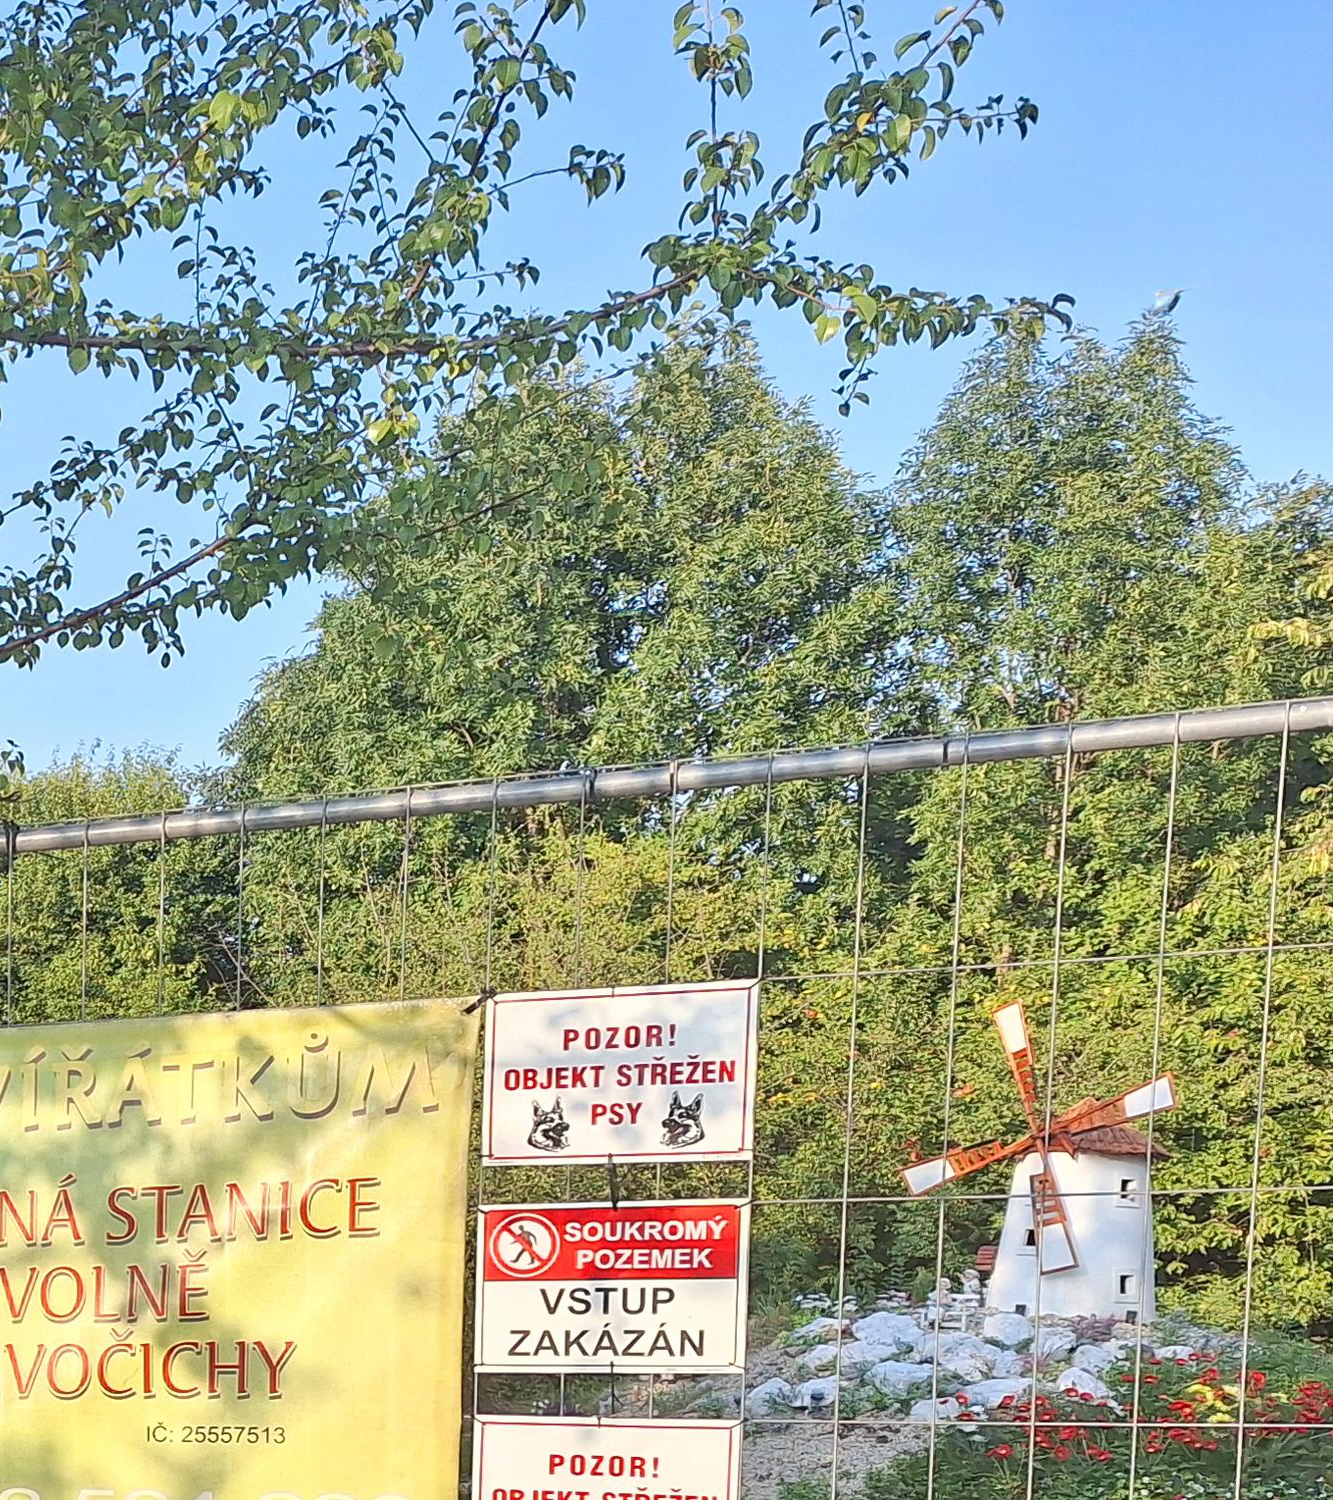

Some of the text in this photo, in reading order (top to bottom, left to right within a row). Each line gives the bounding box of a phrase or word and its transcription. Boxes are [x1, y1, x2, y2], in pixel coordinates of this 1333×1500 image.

[563, 1023, 676, 1051] POZOR!
[504, 1054, 736, 1091] OBJEKT STŘEŽEN
[590, 1102, 643, 1126] PSY
[104, 1176, 382, 1247] STANICE
[563, 1214, 729, 1243] SOUKROMÝ
[576, 1247, 713, 1270] POZEMEK
[539, 1286, 676, 1315] VSTUP
[507, 1322, 705, 1357] ZAKÁZÁN
[146, 1422, 287, 1445] IČ: 25557513
[549, 1454, 659, 1478] POZOR!
